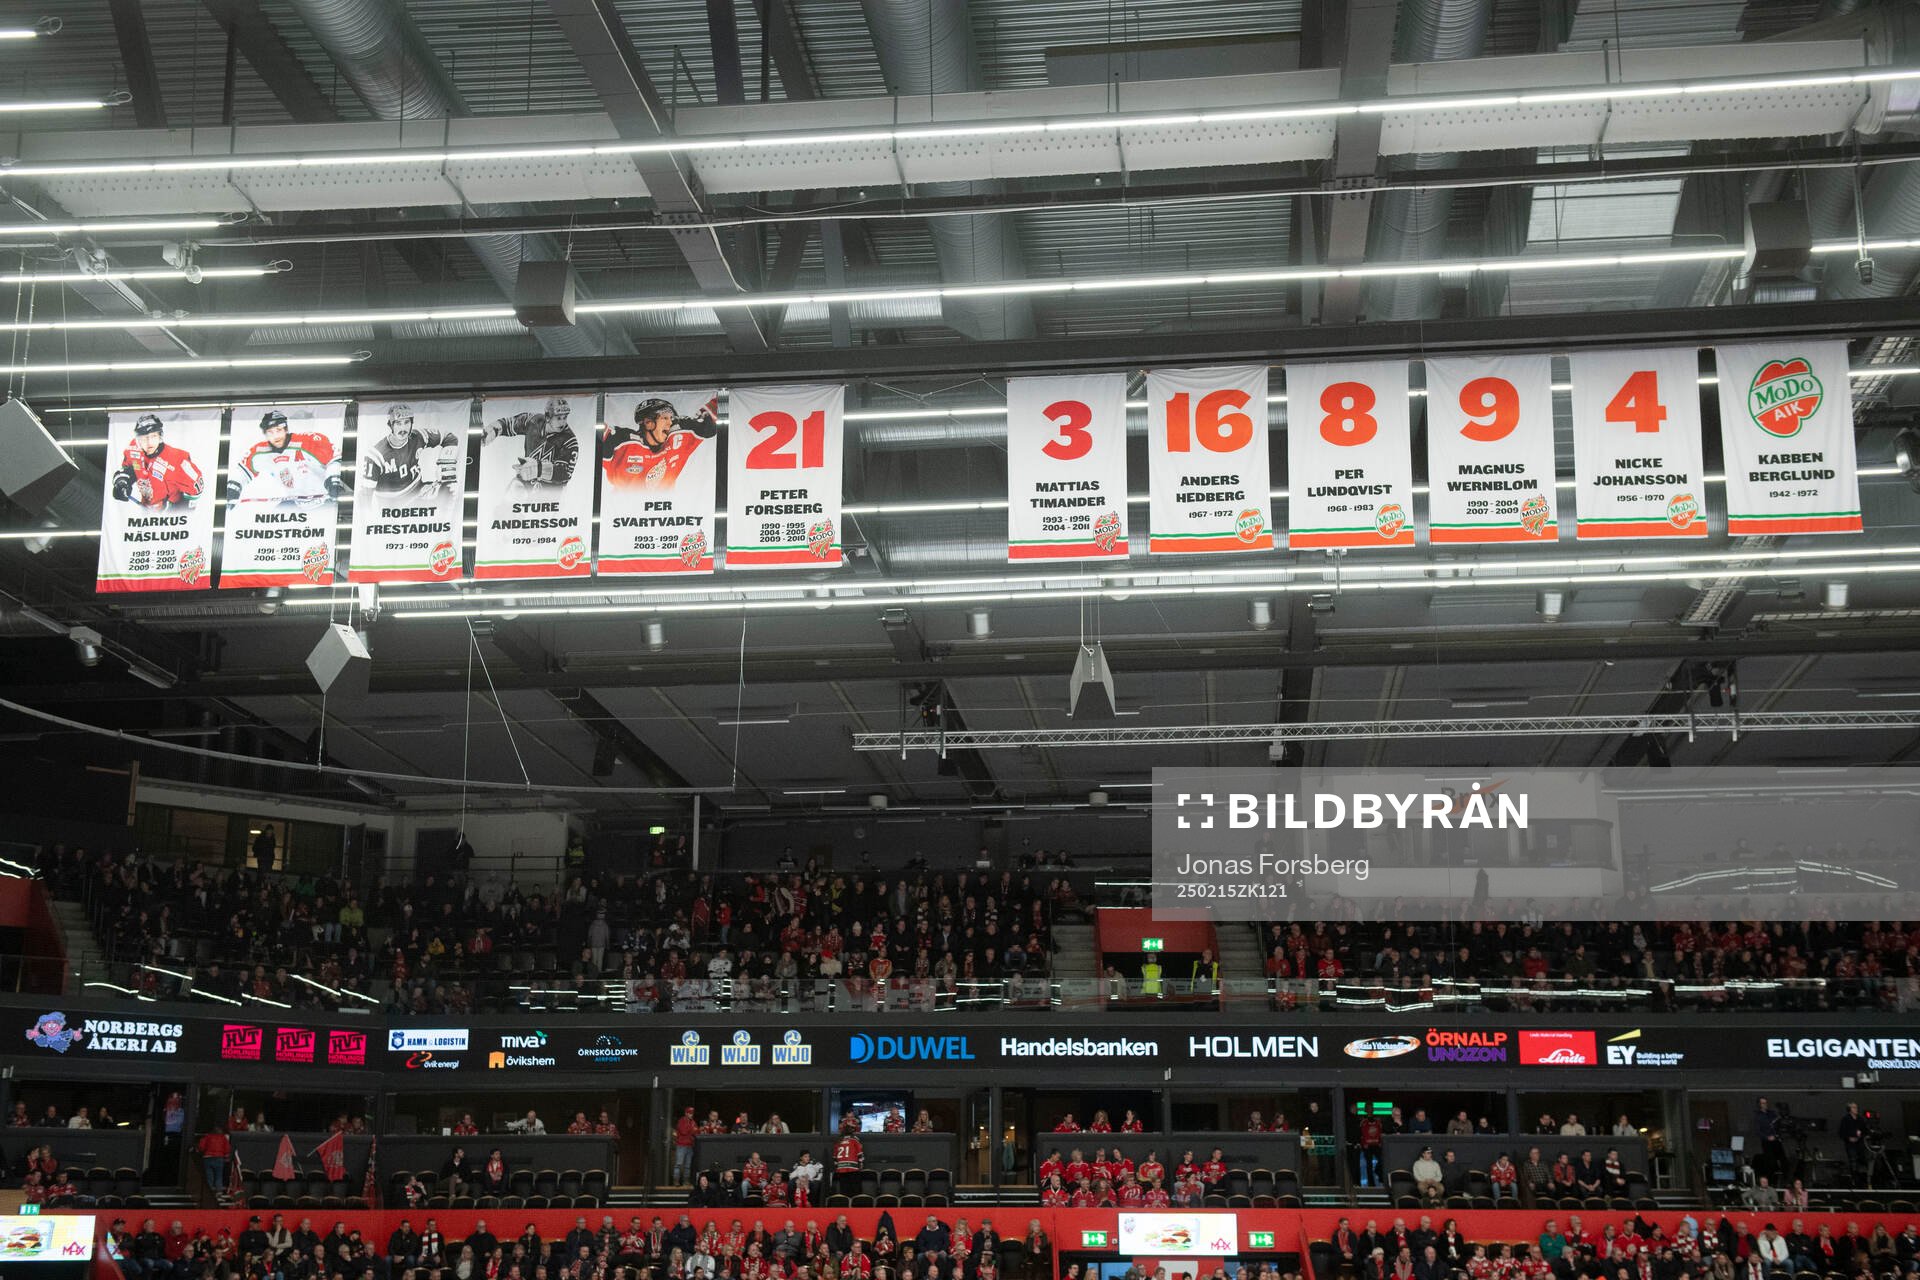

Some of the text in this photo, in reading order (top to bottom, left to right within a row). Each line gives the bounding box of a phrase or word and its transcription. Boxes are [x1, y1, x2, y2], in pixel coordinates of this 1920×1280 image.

[1755, 378, 1813, 409] MoDo
[1605, 370, 1666, 433] 4
[1320, 382, 1378, 446] 8
[1459, 377, 1520, 442] 9
[1775, 402, 1803, 421] AIK
[1166, 389, 1253, 453] 16
[1042, 400, 1093, 460] 3
[746, 411, 825, 469] 21
[1616, 458, 1662, 468] NICKE
[1758, 452, 1823, 464] KABBEN
[1335, 469, 1363, 479] PER
[1459, 464, 1524, 474] MAGNUS
[1181, 475, 1239, 486] ANDERS
[1593, 474, 1687, 486] JOHANSSON
[1750, 470, 1835, 482] BERGLUND
[1036, 481, 1100, 492] MATTIAS
[1308, 485, 1392, 497] LUNDQVIST
[1448, 480, 1537, 491] WERNBLOM
[760, 489, 807, 500] PETER
[1176, 491, 1245, 502] HEDBERG
[512, 503, 559, 513] STURE
[644, 502, 672, 511] PER
[1030, 497, 1105, 508] TIMANDER
[382, 507, 437, 518] ROBERT
[745, 503, 822, 515] FORSBERG
[128, 516, 187, 527] MARKUS
[255, 513, 307, 523] NIKLAS
[492, 517, 577, 529] ANDERSSON
[613, 517, 703, 527] SVARTVADET
[235, 526, 324, 539] SUNDSTRÖM
[366, 523, 450, 535] FRESTADIUS
[124, 531, 189, 542] NÄSLUND
[809, 531, 833, 542] MODO
[681, 541, 706, 552] MODO
[84, 1020, 182, 1037] NORBERGS
[87, 1032, 176, 1053] ÅKERI AB
[225, 1029, 259, 1047] HVT
[280, 1032, 312, 1050] HVT
[1426, 1028, 1507, 1046] ÖRNALP
[332, 1035, 363, 1052] HVT
[877, 1036, 975, 1061] DUWEL
[1001, 1037, 1158, 1057] Handelsbanken
[1190, 1037, 1318, 1057] HOLMEN
[673, 1048, 707, 1062] WIJO
[724, 1048, 758, 1062] WIJO
[775, 1047, 809, 1062] WIJO
[1539, 1048, 1585, 1064] Linde
[1607, 1046, 1636, 1064] EY
[506, 1056, 555, 1066] övikshem
[837, 1146, 849, 1158] 21
[1211, 1238, 1231, 1250] MAX
